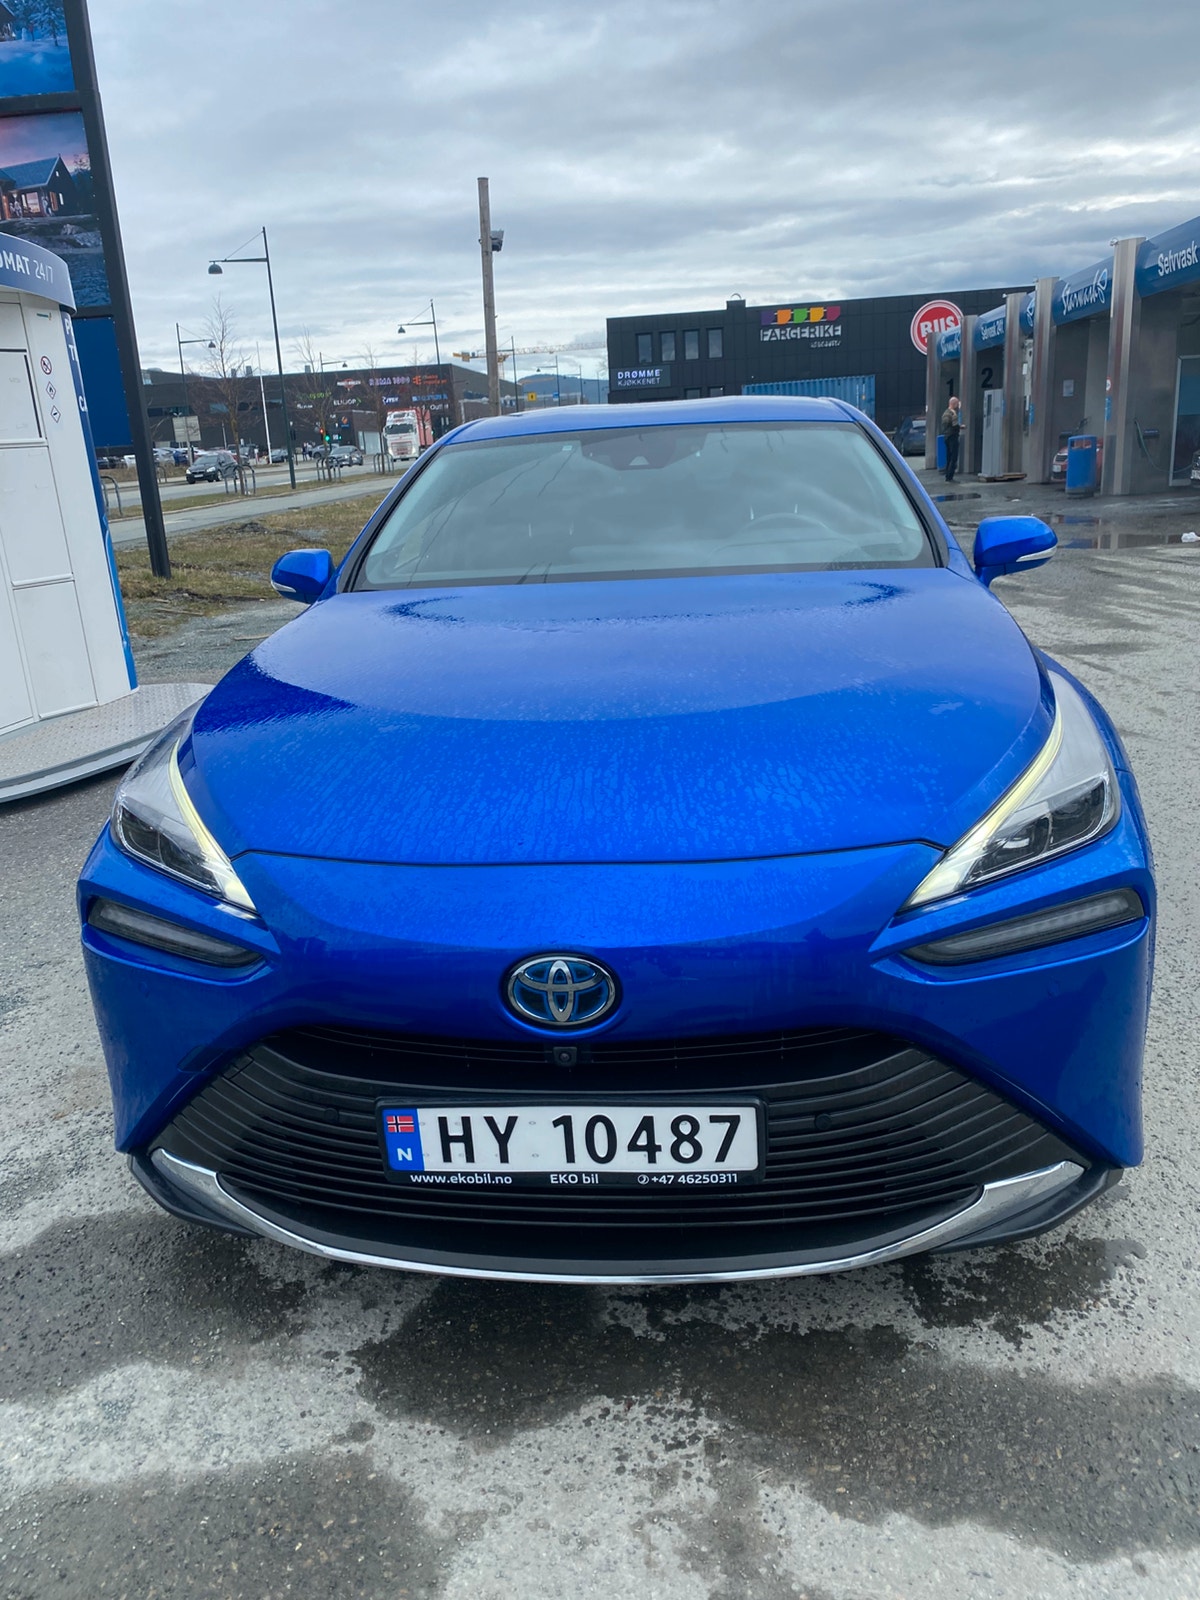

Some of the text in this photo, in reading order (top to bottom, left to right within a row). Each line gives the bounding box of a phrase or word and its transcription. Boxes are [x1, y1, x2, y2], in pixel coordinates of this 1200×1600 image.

[1157, 240, 1199, 277] Selvvask
[33, 260, 53, 284] 24/7
[760, 325, 842, 341] FARGERIKE
[617, 369, 661, 379] DRØMME
[617, 378, 661, 387] KJØKKENET
[981, 367, 993, 389] 2
[946, 378, 955, 397] 1
[437, 1114, 741, 1165] HY 10487
[396, 1147, 413, 1162] N
[410, 1173, 738, 1186] www.ekobil.no EKO bil +47 46250311
